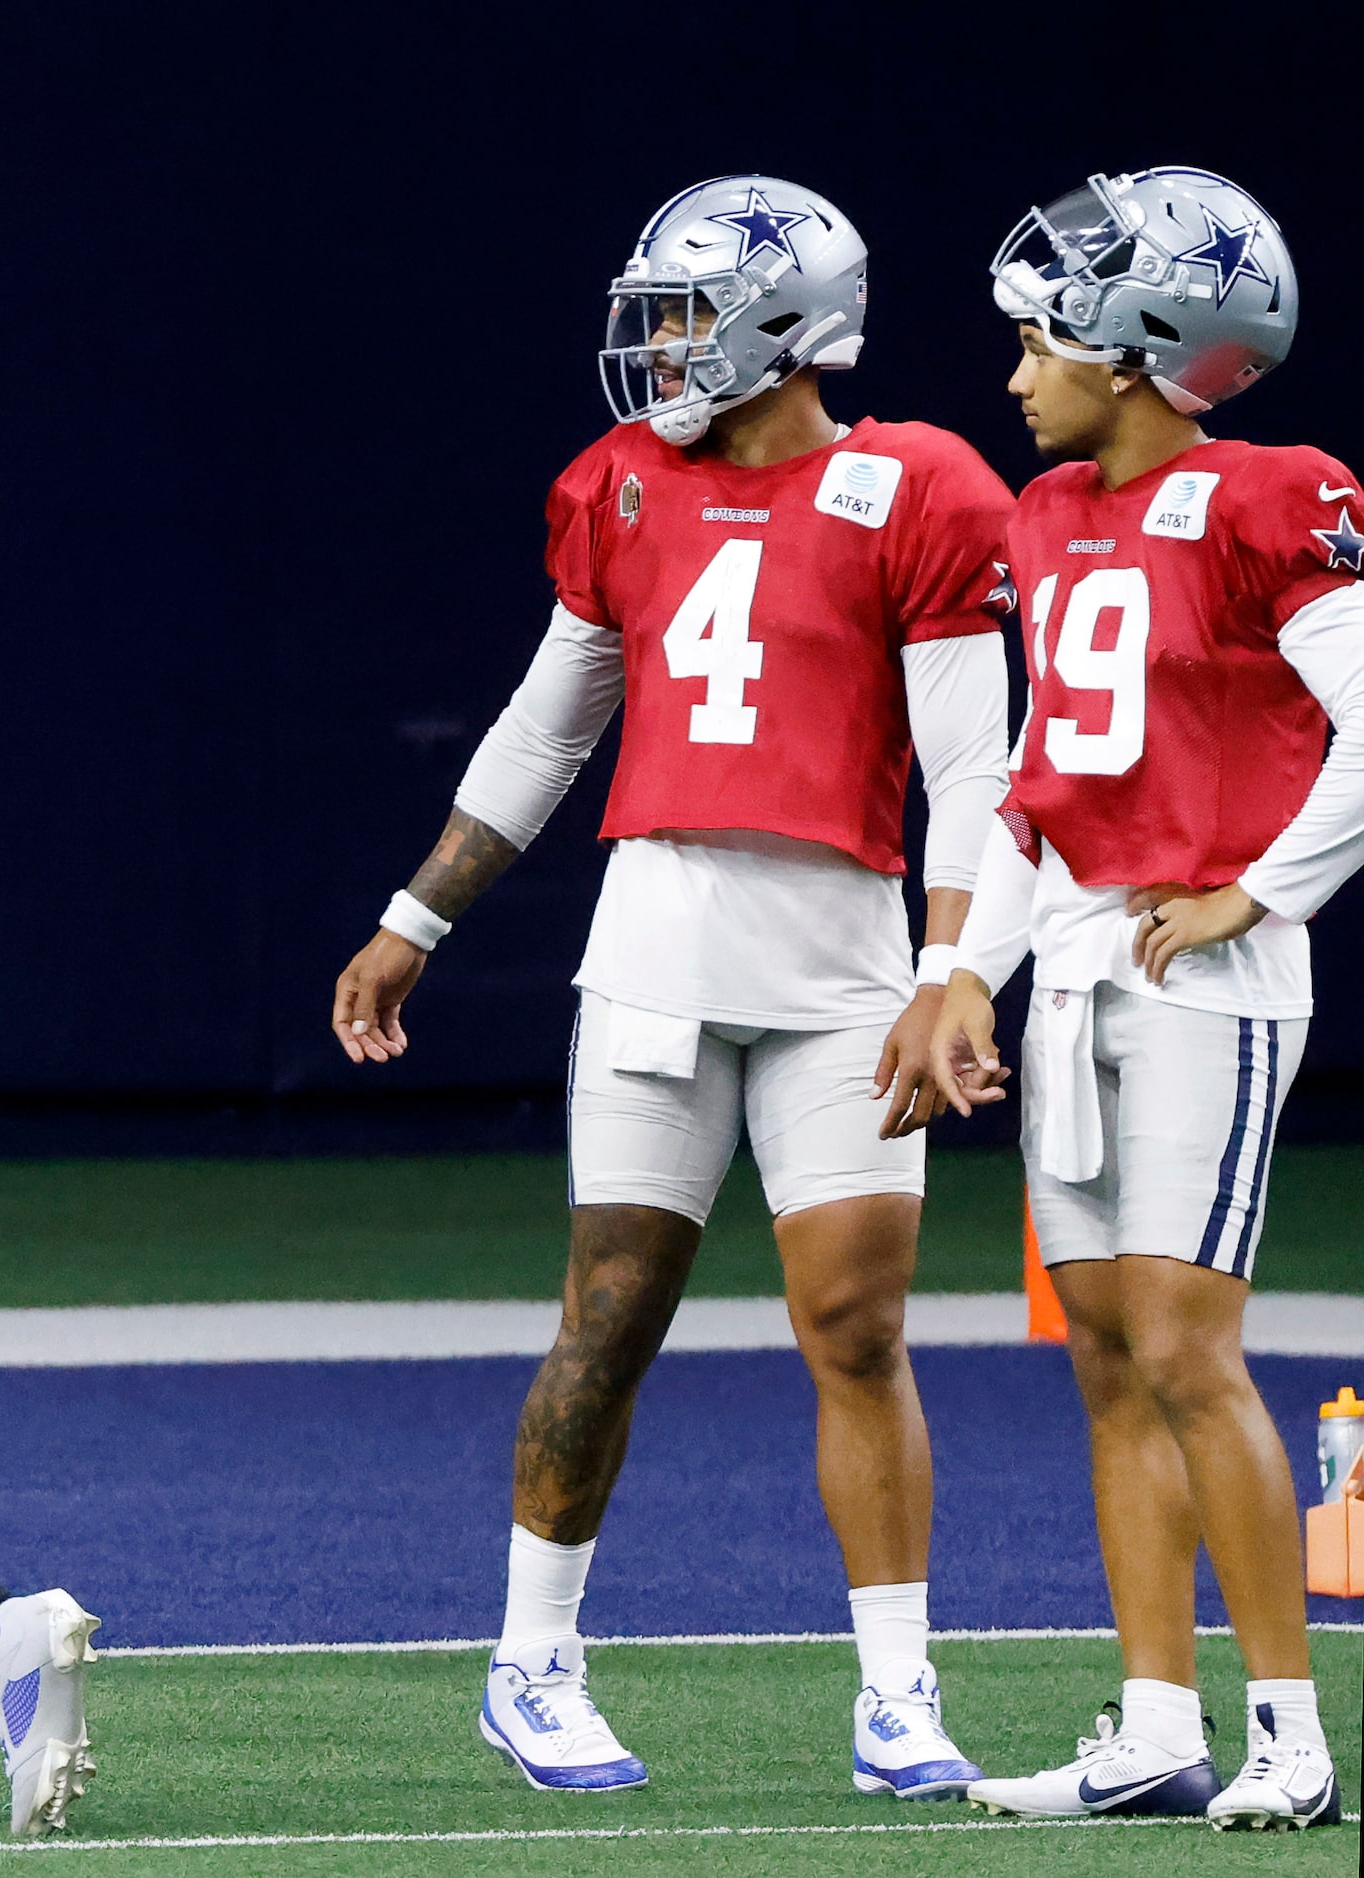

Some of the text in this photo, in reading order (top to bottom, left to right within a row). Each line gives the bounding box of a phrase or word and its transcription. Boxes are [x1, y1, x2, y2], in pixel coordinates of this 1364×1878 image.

[702, 507, 771, 522] COWBOYS
[832, 493, 875, 516] AT&T
[1156, 513, 1191, 529] AT&T
[662, 538, 764, 744] 4
[1008, 567, 1151, 776] 19
